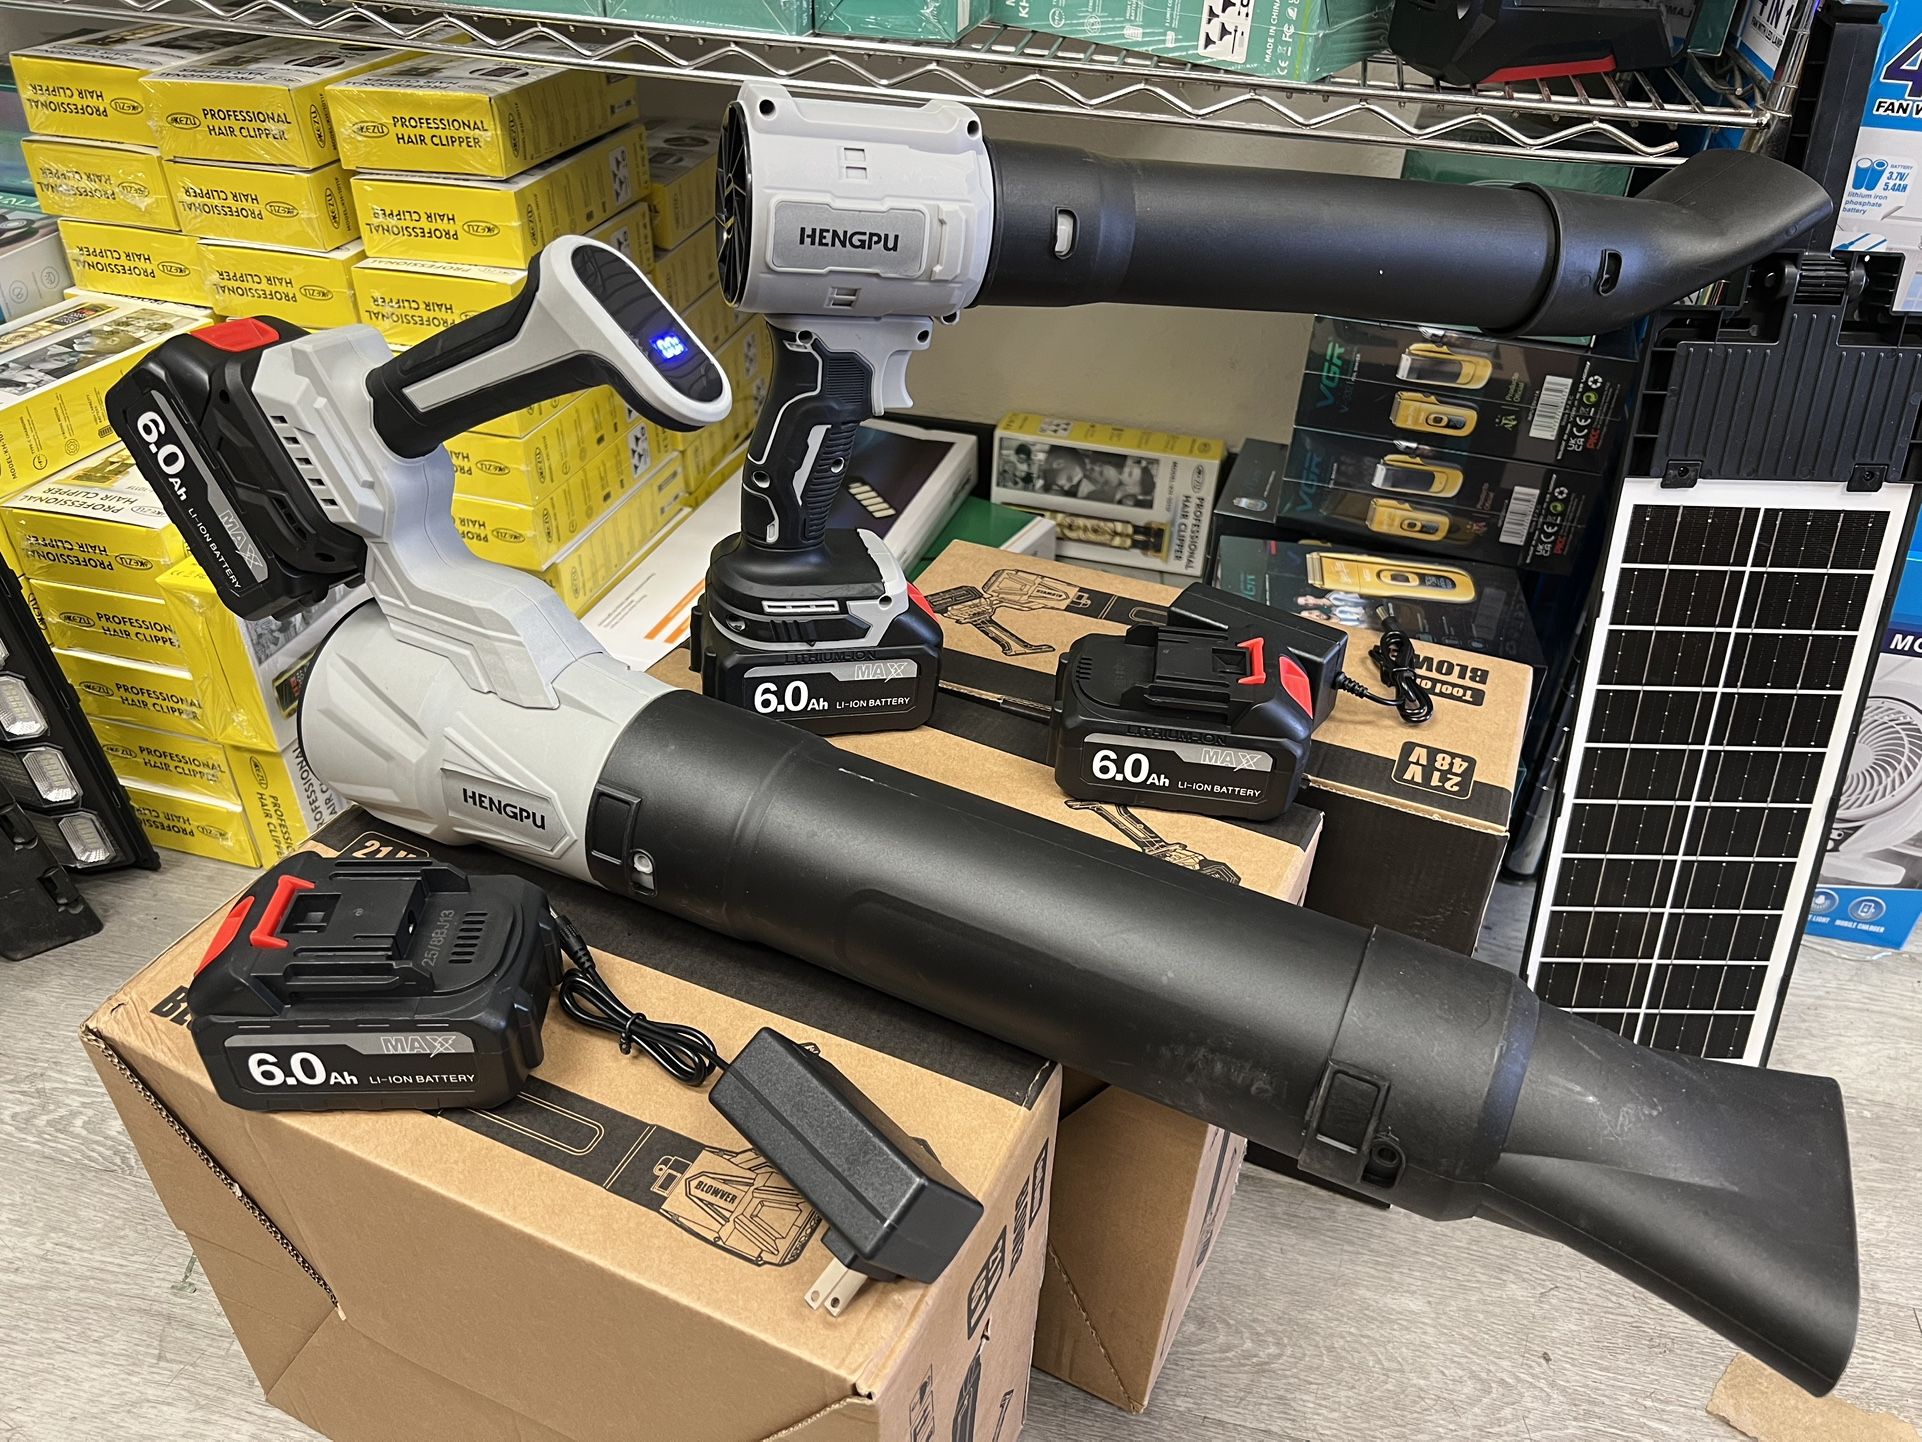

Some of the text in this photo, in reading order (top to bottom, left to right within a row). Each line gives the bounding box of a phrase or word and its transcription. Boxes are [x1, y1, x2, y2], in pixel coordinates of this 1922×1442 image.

[1264, 40, 1273, 62] MADE
[1270, 27, 1275, 38] IN
[29, 83, 105, 101] HAIR CLIPPER
[29, 98, 108, 118] PROFESSIONAL
[202, 108, 292, 125] PROFESSIONAL
[1875, 100, 1910, 116] FAN
[208, 125, 288, 141] HAIR CLIPPER
[392, 116, 488, 132] PROFESSIONAL
[396, 133, 482, 149] HAIR CLIPPER
[183, 186, 259, 204] HAIR CLIPPER
[1873, 192, 1888, 200] iron
[1883, 182, 1908, 193] 5.4AH
[179, 201, 264, 220] PROFESSIONAL
[1842, 206, 1867, 215] battery
[1844, 199, 1882, 208] phosphate
[372, 208, 456, 224] HAIR CLIPPER
[365, 223, 459, 240] PROFESSIONAL
[799, 226, 900, 253] HENGPU
[76, 245, 152, 264] HAIR CLIPPER
[72, 259, 156, 278] PROFESSIONAL
[217, 270, 293, 288] HAIR CLIPPER
[213, 283, 297, 302] PROFESSIONAL
[371, 296, 453, 313] HAIR CLIPPER
[1316, 342, 1345, 408] VGR
[19, 495, 125, 514] PROFESSIONAL
[42, 487, 139, 505] HAIR CLIPPER
[137, 411, 188, 501] 6.0Ah
[188, 508, 212, 542] LI-ION
[210, 543, 242, 589] BATTERY
[458, 517, 486, 529] HAIR
[1175, 495, 1191, 560] HAIR CLIPPER
[220, 509, 263, 568] MAX
[1185, 497, 1205, 570] PROFESSIONAL
[75, 543, 108, 556] HAIR
[102, 626, 132, 640] HAIR
[855, 662, 908, 683] MAX
[754, 681, 910, 713] 6.0Ah LI-ION BATTERY
[1435, 683, 1473, 701] Tool
[120, 696, 150, 710] HAIR
[138, 745, 226, 773] PROFESSIONAL
[143, 758, 172, 773] HAIR
[1200, 748, 1262, 772] MAX
[1408, 746, 1469, 774] 48 V
[1092, 750, 1261, 798] 6.0Ah LI-ION BATTERY
[1403, 764, 1462, 792] 21 V
[256, 791, 273, 819] HAIR
[463, 788, 545, 830] HENGPU
[164, 812, 192, 825] HAIR
[352, 840, 394, 858] 21
[1835, 920, 1885, 932] MOBILE CHARGER
[380, 1035, 456, 1059] MAX
[248, 1052, 475, 1086] 6.0Ah LI-ION BATTERY
